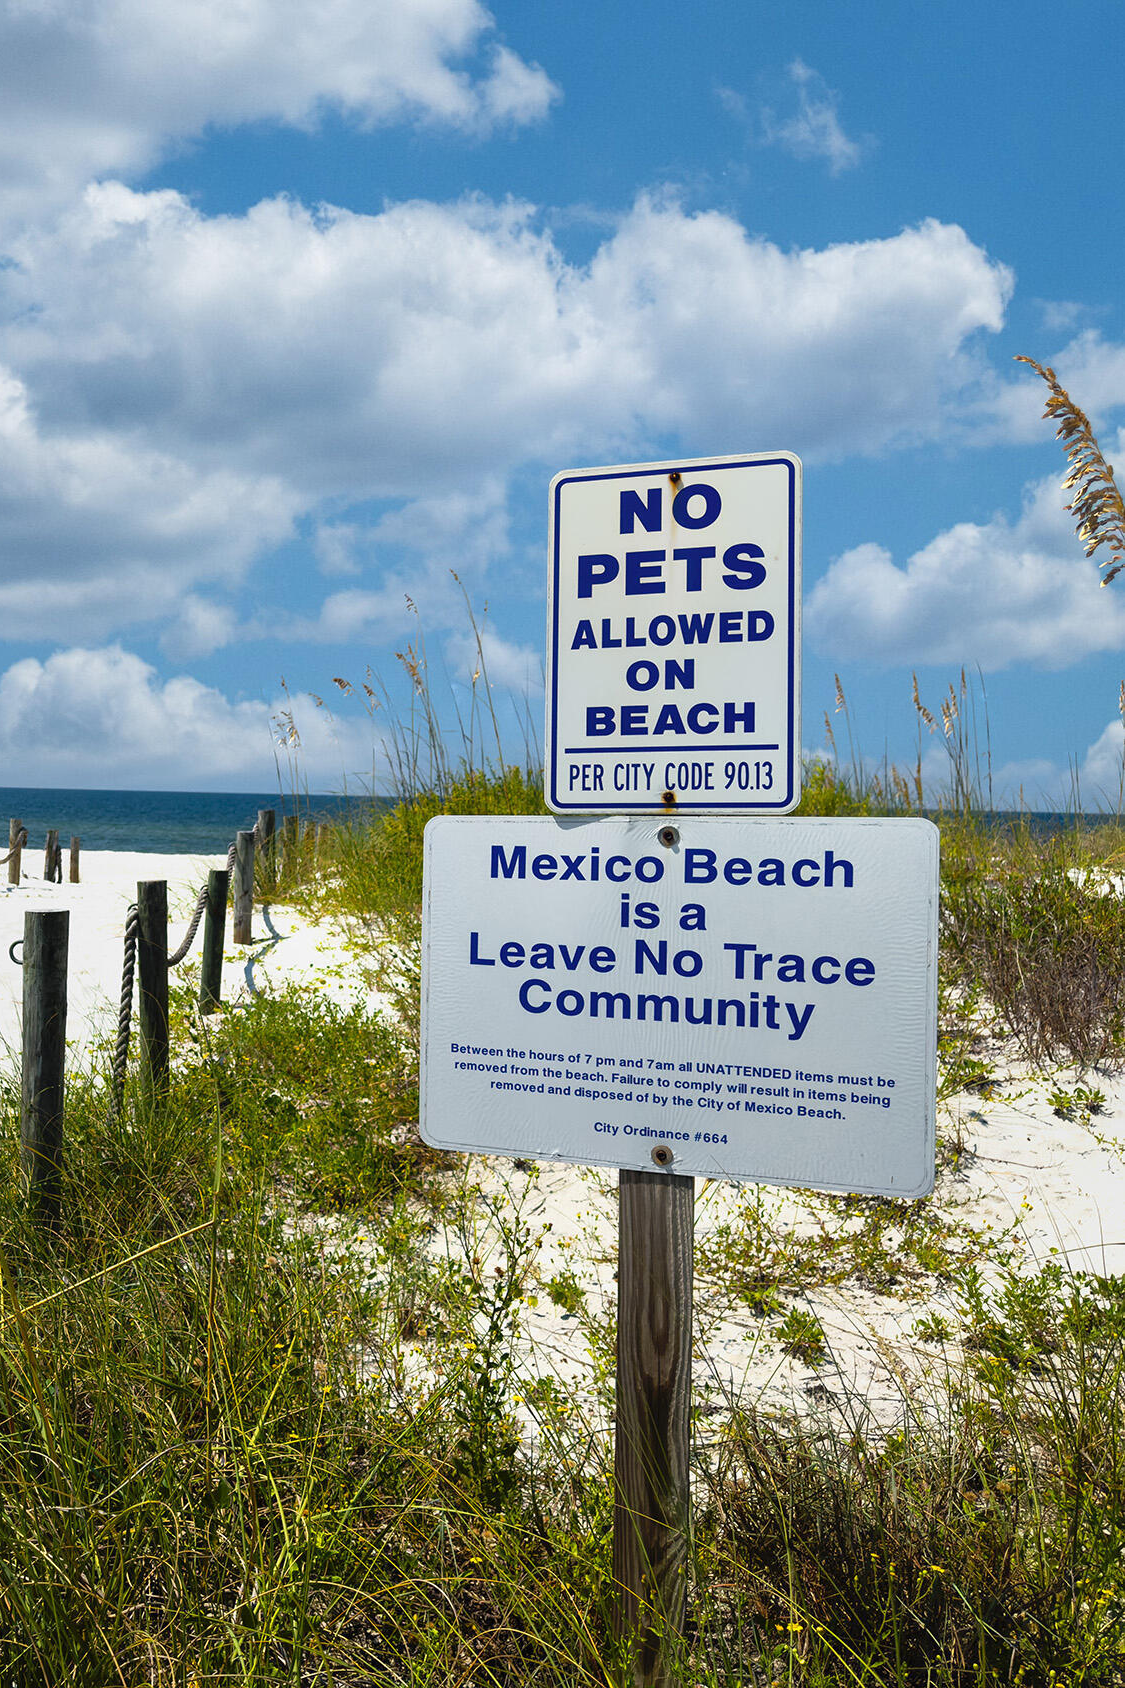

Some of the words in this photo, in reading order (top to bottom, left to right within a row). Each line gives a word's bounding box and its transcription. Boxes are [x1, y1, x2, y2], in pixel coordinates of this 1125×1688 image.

[620, 484, 722, 535] NO
[577, 543, 767, 599] PETS
[570, 610, 775, 651] ALLOWED
[625, 658, 695, 692] ON
[585, 701, 756, 737] BEACH
[569, 763, 605, 792] PER
[613, 762, 655, 792] CITY
[665, 762, 715, 791] CODE
[724, 761, 774, 791] 90.13
[490, 844, 665, 884] Mexico
[684, 848, 854, 888] Beach
[620, 892, 661, 930] is
[679, 903, 707, 931] a
[469, 931, 617, 974] Leave
[634, 939, 704, 978] No
[723, 942, 876, 987] Trace
[518, 978, 816, 1041] Community
[451, 1043, 503, 1057] Between
[506, 1048, 526, 1059] the
[529, 1049, 564, 1062] hours
[568, 1053, 581, 1063] of
[585, 1054, 592, 1064] 7
[596, 1057, 615, 1067] pm
[619, 1058, 643, 1068] and
[647, 1059, 675, 1071] 7am
[678, 1062, 692, 1072] all
[696, 1062, 792, 1080] UNATTENDED
[795, 1070, 834, 1083] items
[838, 1075, 873, 1086] must
[877, 1076, 895, 1088] be
[455, 1062, 507, 1073] removed
[510, 1064, 539, 1076] from
[542, 1067, 562, 1078] the
[566, 1069, 608, 1082] beach.
[611, 1073, 654, 1086] Failure
[657, 1077, 670, 1088] to
[674, 1080, 723, 1094] comply
[726, 1083, 747, 1094] will
[750, 1086, 790, 1098] result
[793, 1087, 805, 1099] in
[808, 1089, 847, 1102] items
[851, 1092, 891, 1108] being
[491, 1081, 544, 1093] removed
[547, 1086, 571, 1096] and
[574, 1087, 633, 1101] disposed
[636, 1093, 649, 1103] of
[652, 1093, 668, 1107] by
[672, 1095, 693, 1107] the
[697, 1097, 724, 1112] City
[727, 1100, 741, 1111] of
[745, 1101, 793, 1115] Mexico
[797, 1105, 846, 1120] Beach.
[594, 1122, 619, 1136] City
[623, 1124, 690, 1141] Ordinance
[694, 1132, 728, 1144] #664
